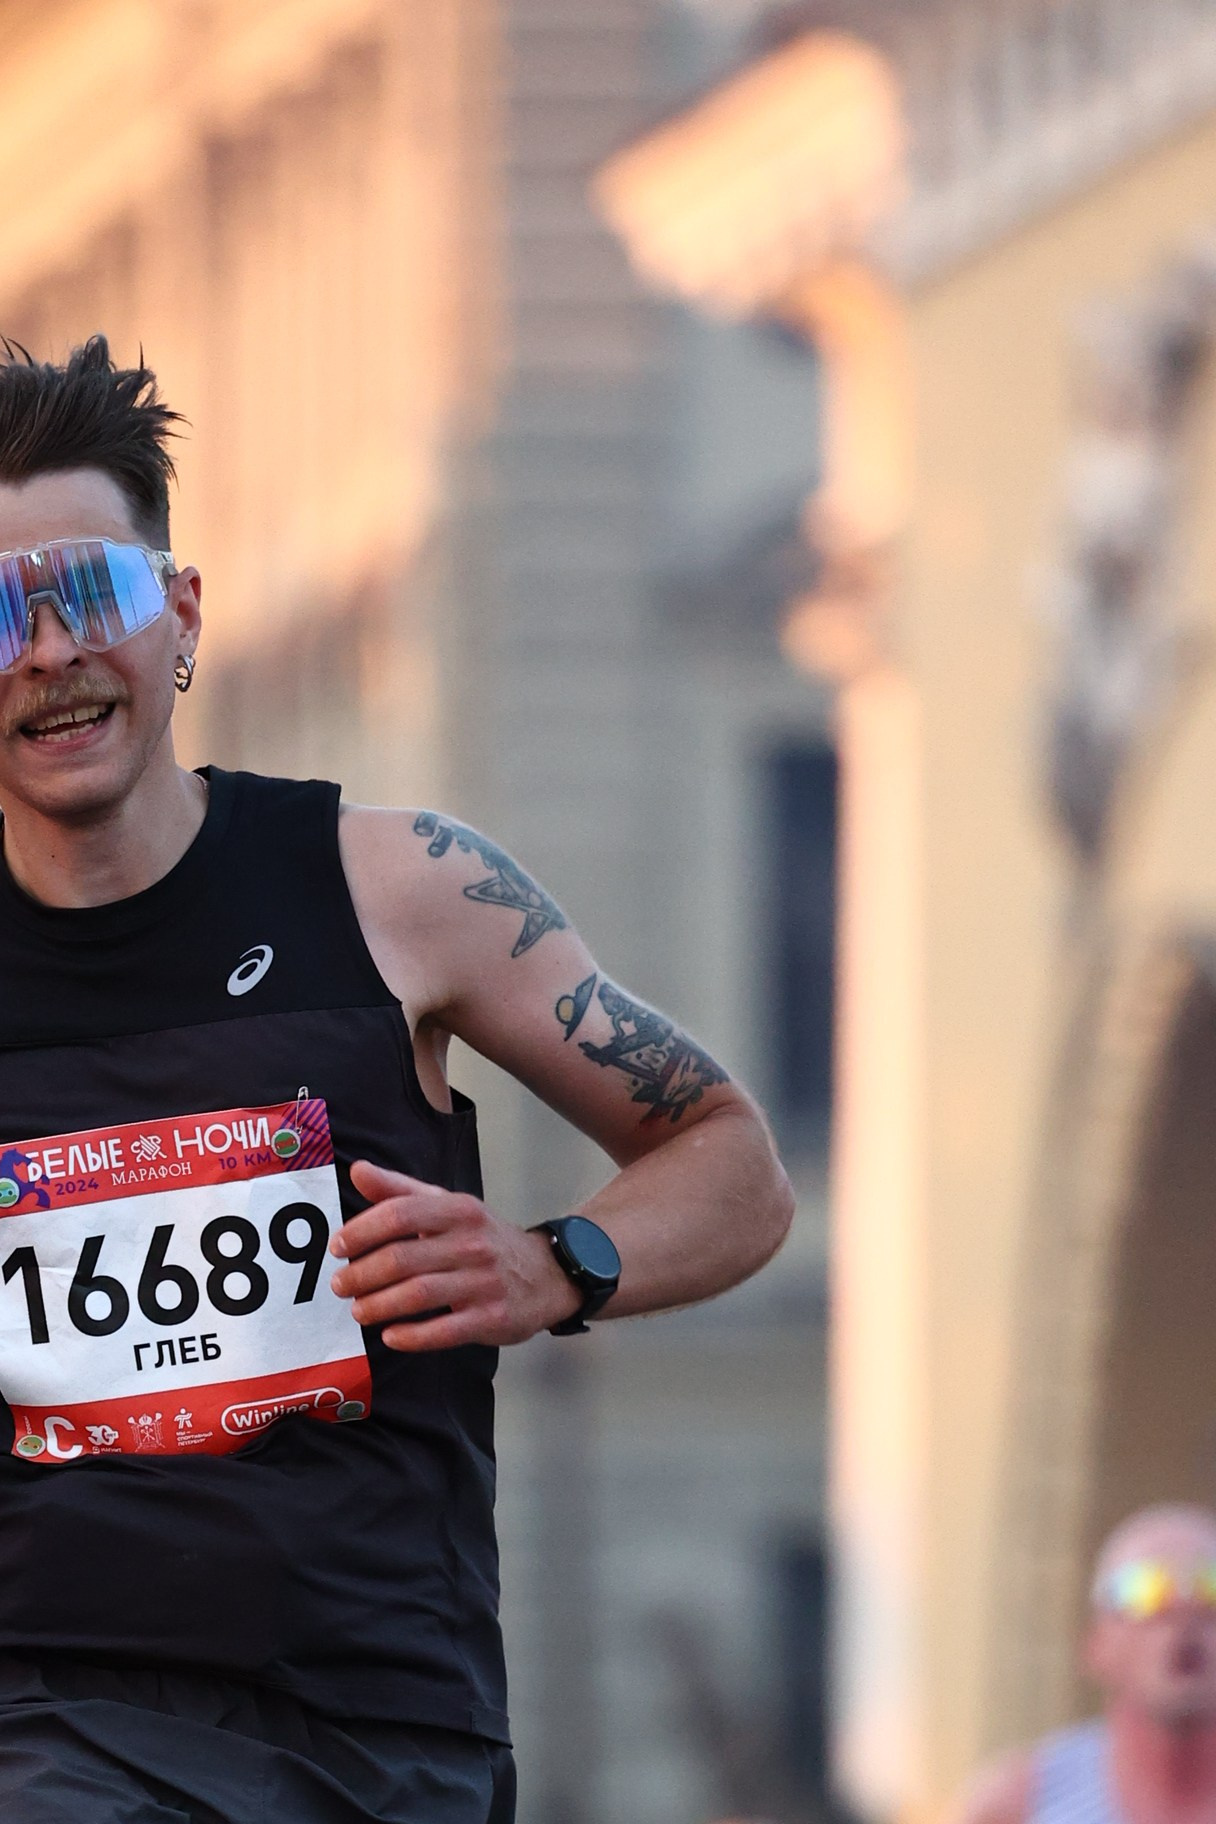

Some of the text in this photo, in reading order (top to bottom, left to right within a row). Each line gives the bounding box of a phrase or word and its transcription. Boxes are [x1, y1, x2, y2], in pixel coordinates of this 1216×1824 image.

[25, 1117, 271, 1182] БЕЛЫЕ НОЧИ
[219, 1157, 238, 1170] 10
[55, 1178, 99, 1196] 2024
[111, 1162, 193, 1186] МАРАФОН
[1, 1202, 330, 1345] 16689
[133, 1333, 222, 1371] ГЛЕБ
